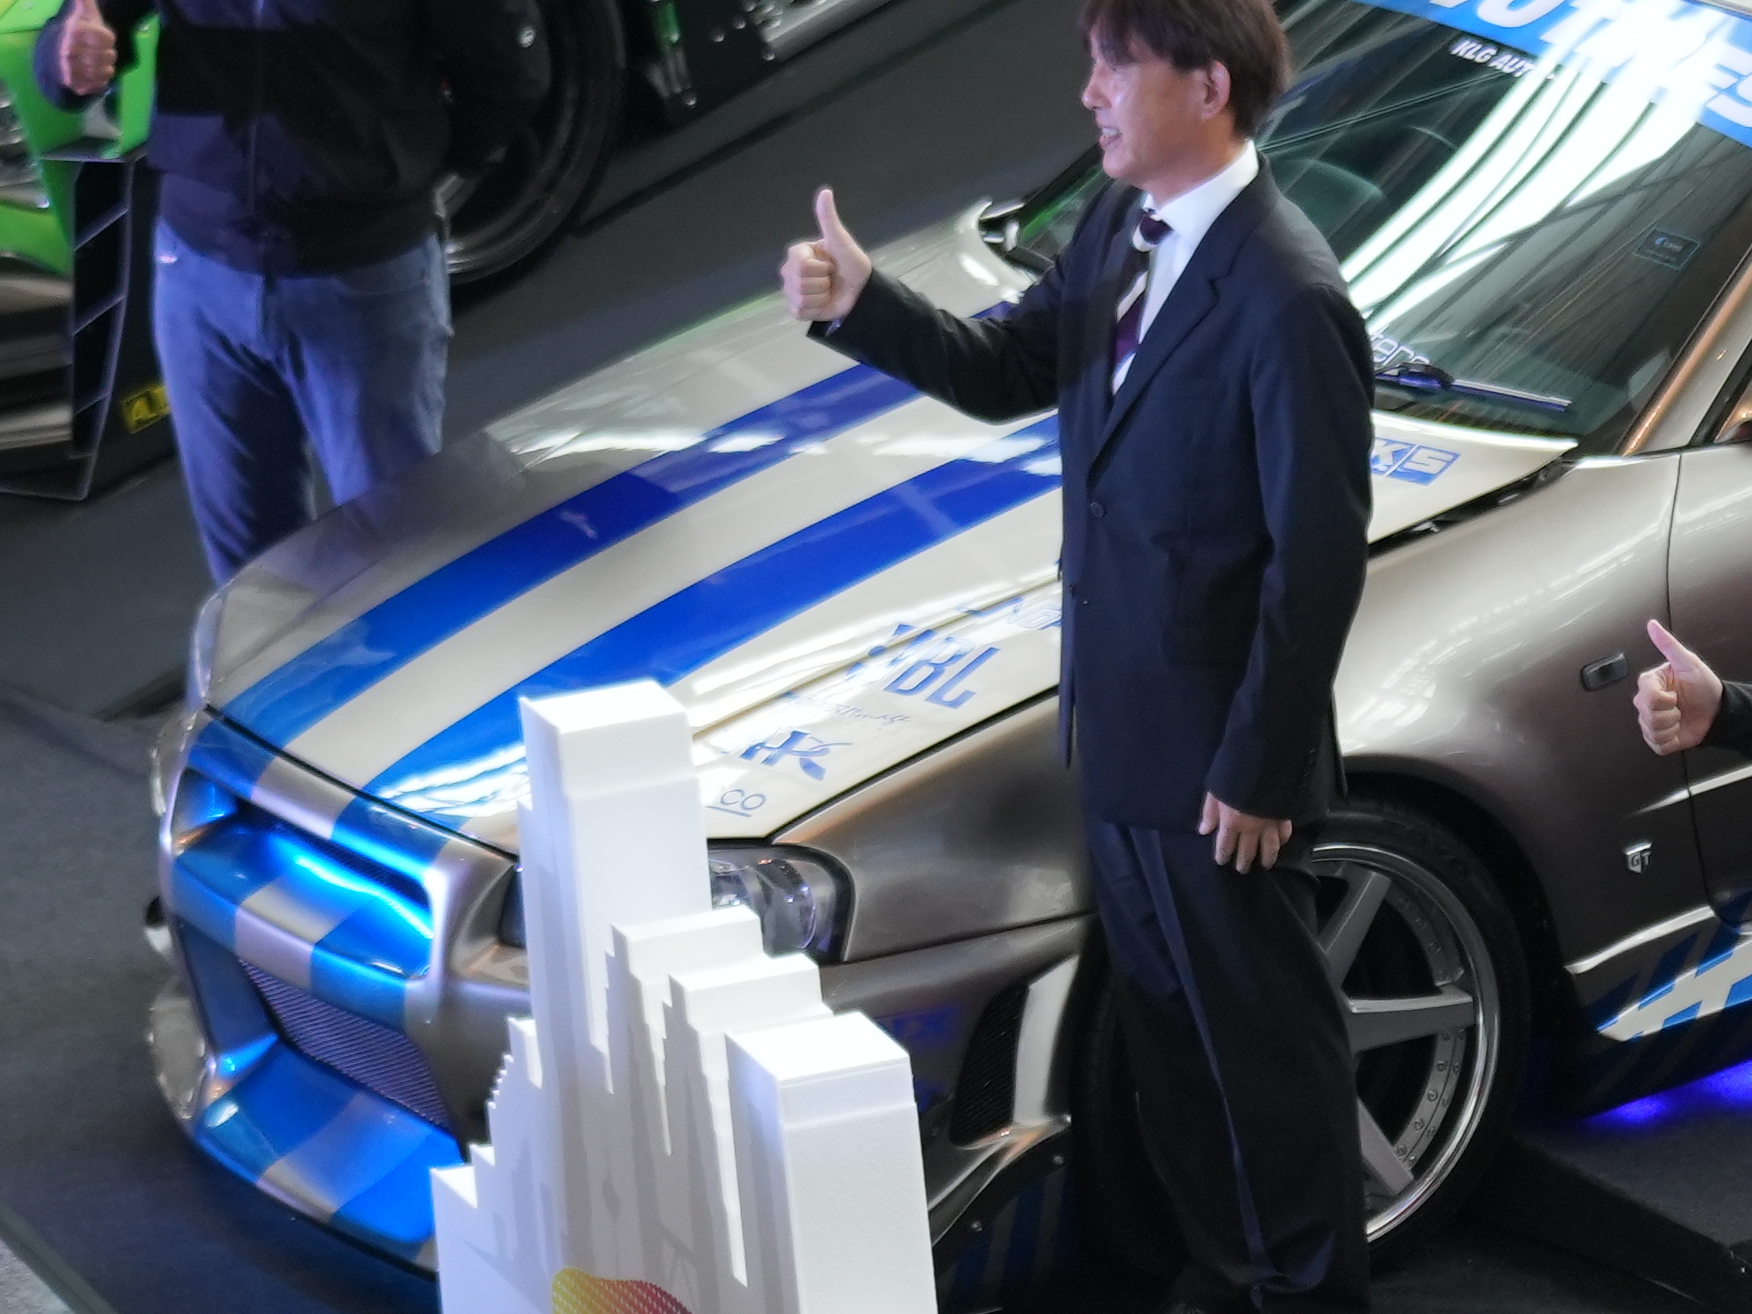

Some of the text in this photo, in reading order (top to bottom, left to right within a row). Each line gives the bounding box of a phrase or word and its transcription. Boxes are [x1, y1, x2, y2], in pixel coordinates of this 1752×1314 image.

[1450, 39, 1556, 81] KLG AUT
[1371, 437, 1462, 486] KS
